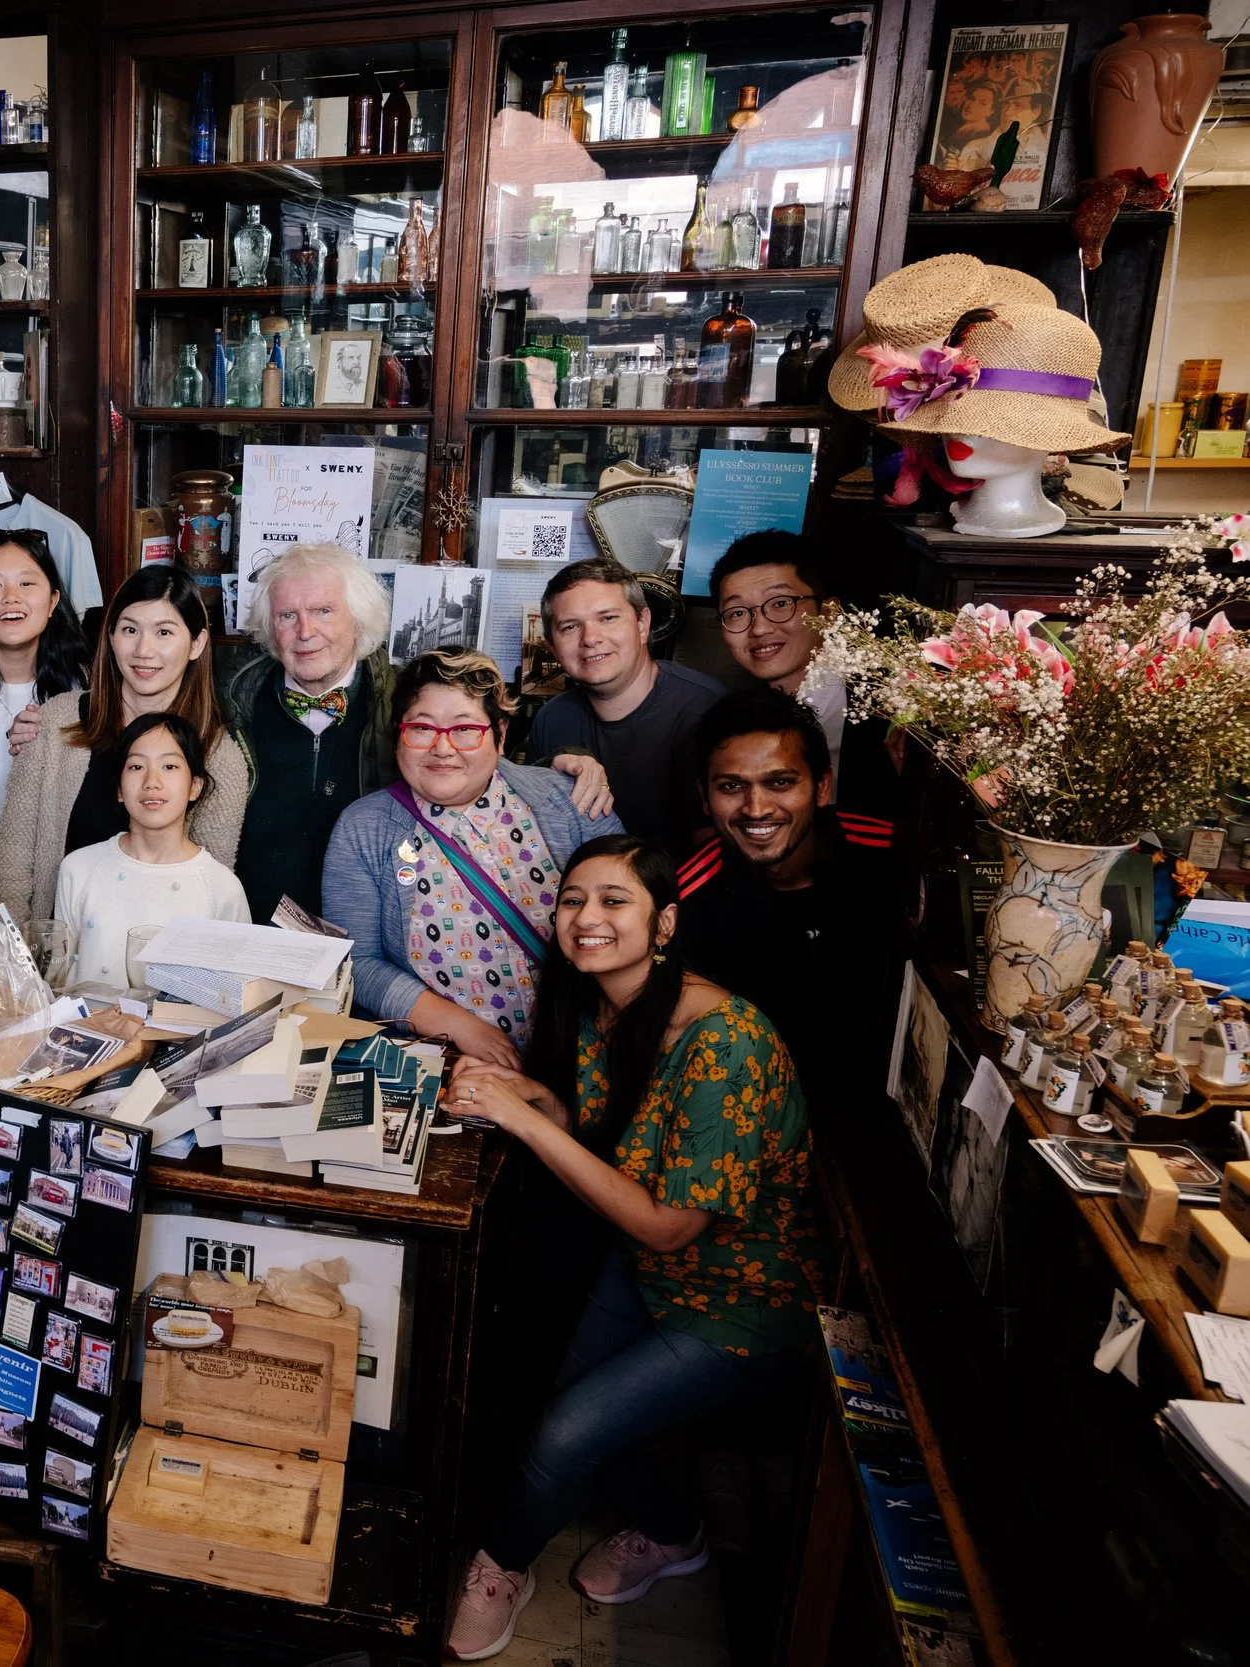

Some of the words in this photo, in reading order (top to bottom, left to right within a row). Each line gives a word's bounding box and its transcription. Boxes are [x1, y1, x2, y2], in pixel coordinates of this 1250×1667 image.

[953, 36, 985, 51] BOGART
[986, 34, 1025, 50] BERGMAN
[1028, 32, 1065, 48] HENREID
[762, 463, 805, 473] SUMMER
[725, 474, 754, 483] BOOK
[756, 475, 782, 484] CLUB
[274, 486, 340, 522] Bloomsday
[230, 1360, 243, 1368] AND
[1, 1369, 32, 1386] Museum
[255, 1370, 298, 1382] WESTLAND
[847, 1396, 908, 1420] alkey
